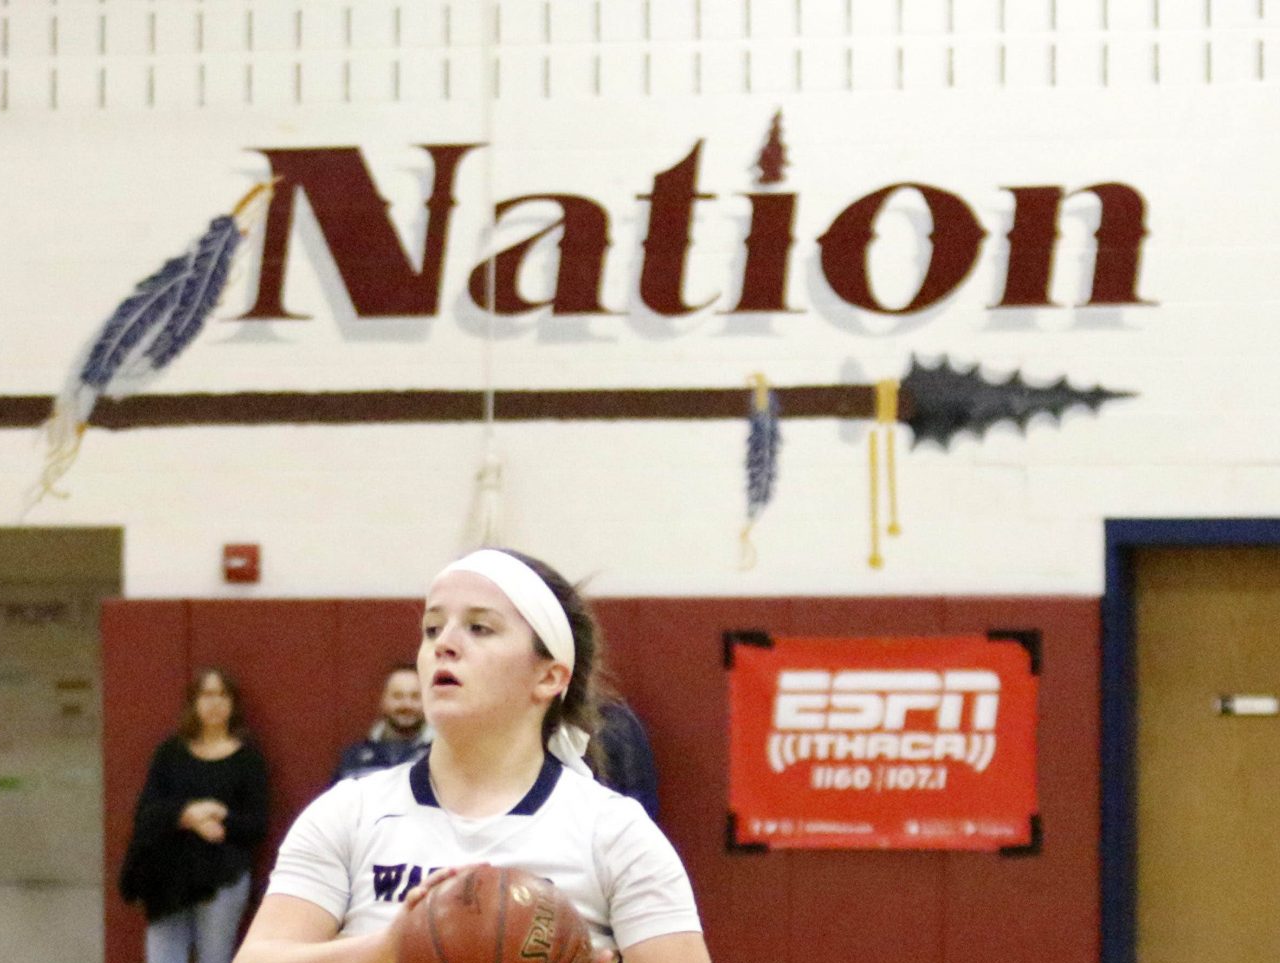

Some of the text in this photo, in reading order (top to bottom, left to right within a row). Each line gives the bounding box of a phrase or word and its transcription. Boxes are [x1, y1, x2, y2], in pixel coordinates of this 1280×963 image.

[217, 106, 1161, 321] Nation
[773, 669, 1001, 730] ESPN
[798, 732, 967, 761] ITHACA
